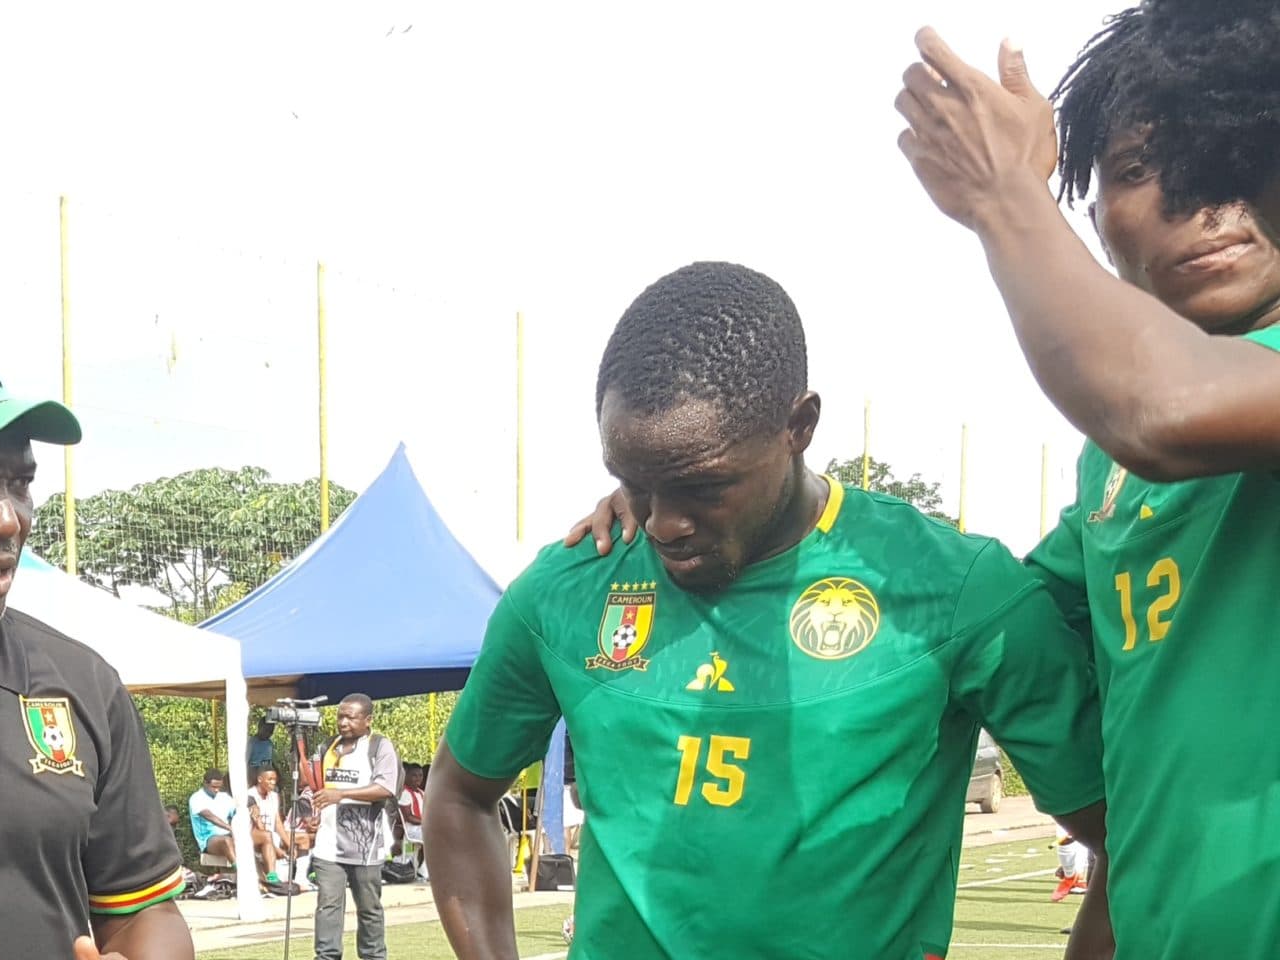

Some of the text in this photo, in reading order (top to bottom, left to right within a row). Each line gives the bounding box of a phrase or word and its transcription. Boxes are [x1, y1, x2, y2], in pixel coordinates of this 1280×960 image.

[611, 595, 653, 604] CAMEROUN
[1116, 559, 1181, 651] 12
[675, 735, 751, 807] 15
